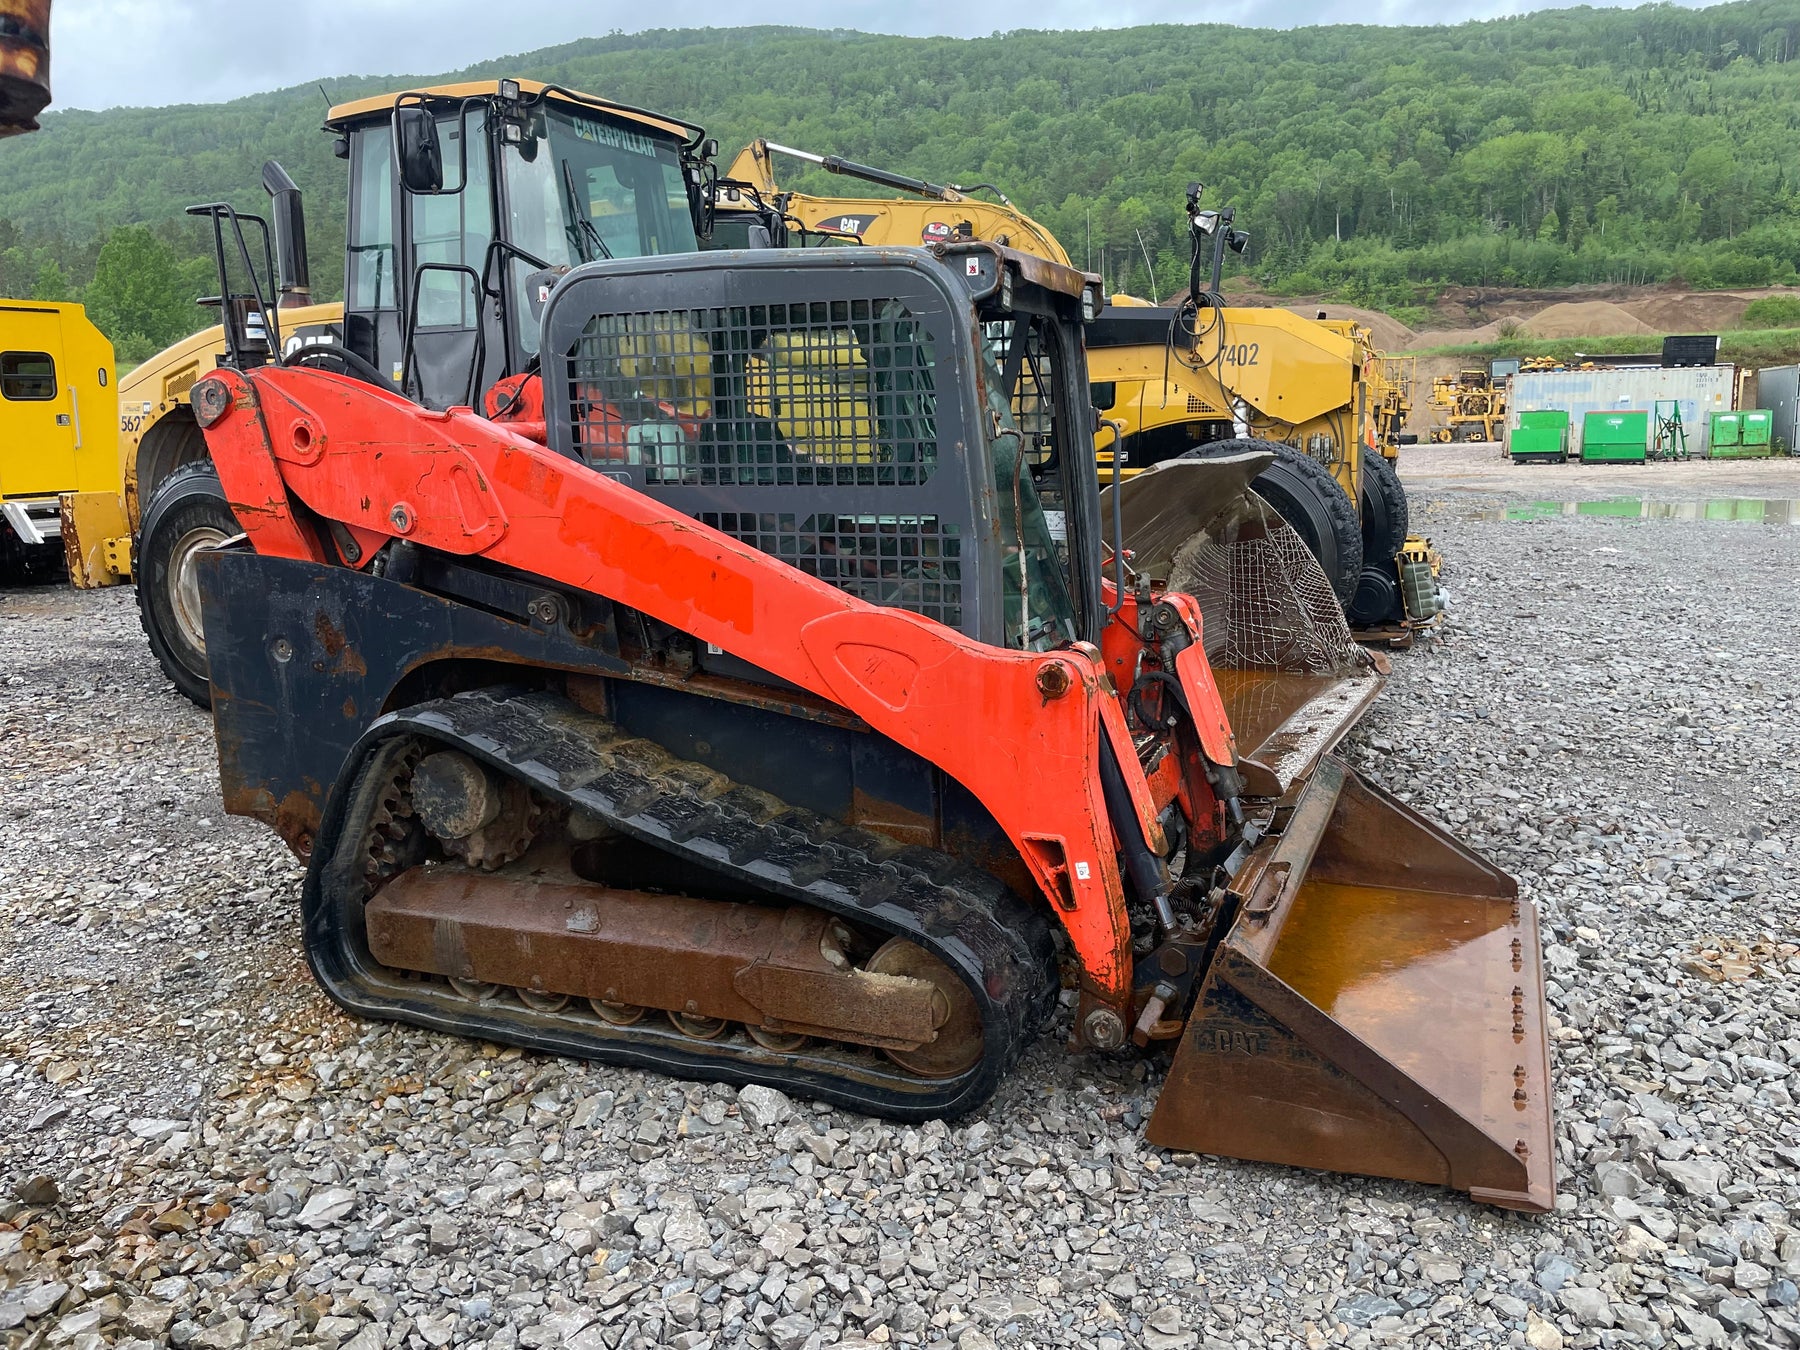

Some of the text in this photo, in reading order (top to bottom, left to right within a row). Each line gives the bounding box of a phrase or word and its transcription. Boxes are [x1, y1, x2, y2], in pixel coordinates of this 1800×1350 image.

[572, 116, 656, 157] CATERPILLAR
[840, 217, 860, 234] CAT
[1219, 343, 1259, 367] 7402
[1215, 1029, 1259, 1056] CAT
